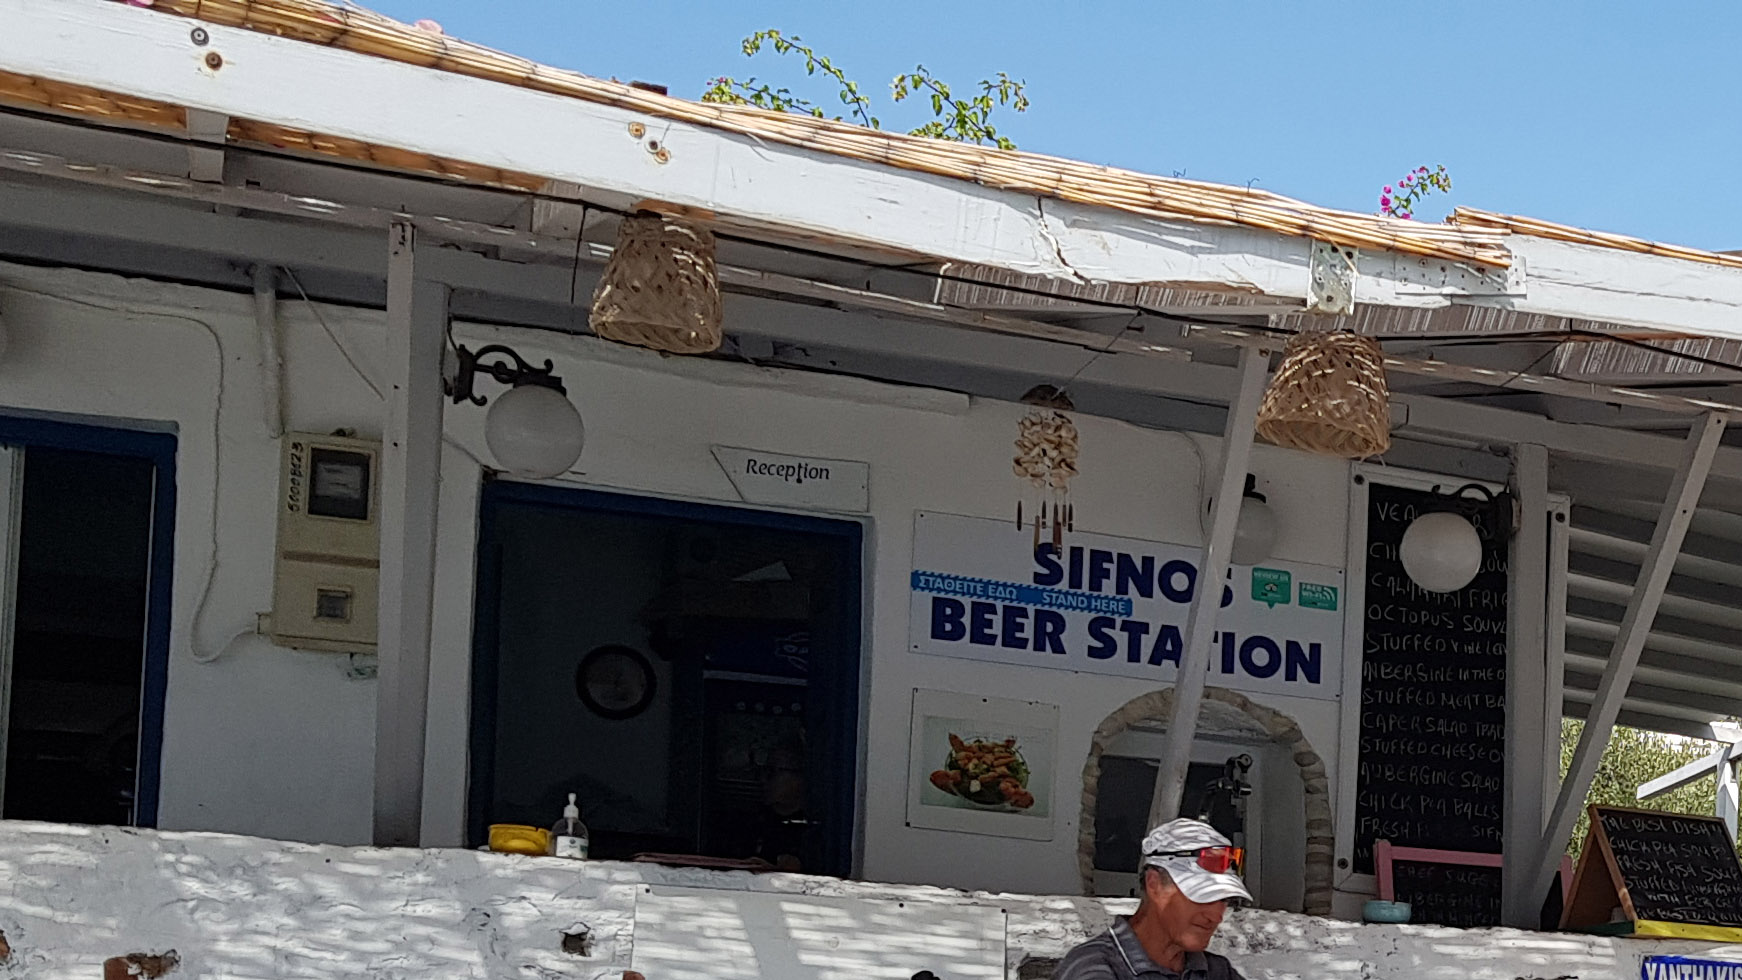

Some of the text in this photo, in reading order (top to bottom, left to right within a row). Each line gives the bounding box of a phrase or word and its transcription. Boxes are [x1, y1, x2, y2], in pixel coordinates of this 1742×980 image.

[746, 458, 830, 484] Reception
[918, 575, 1018, 600] ΣΤΑΘΕΙΤΕ ΕΔΩ
[1041, 591, 1126, 613] STAND HERE
[1367, 603, 1454, 629] OCTOPUS
[930, 596, 1322, 684] BEER STAION
[1365, 632, 1446, 654] STUFFED
[1361, 686, 1436, 706] STUFFED
[1485, 694, 1506, 710] BA
[1362, 711, 1422, 734] CAPER
[1360, 735, 1428, 755] STUFFED
[1360, 815, 1410, 839] FRESH
